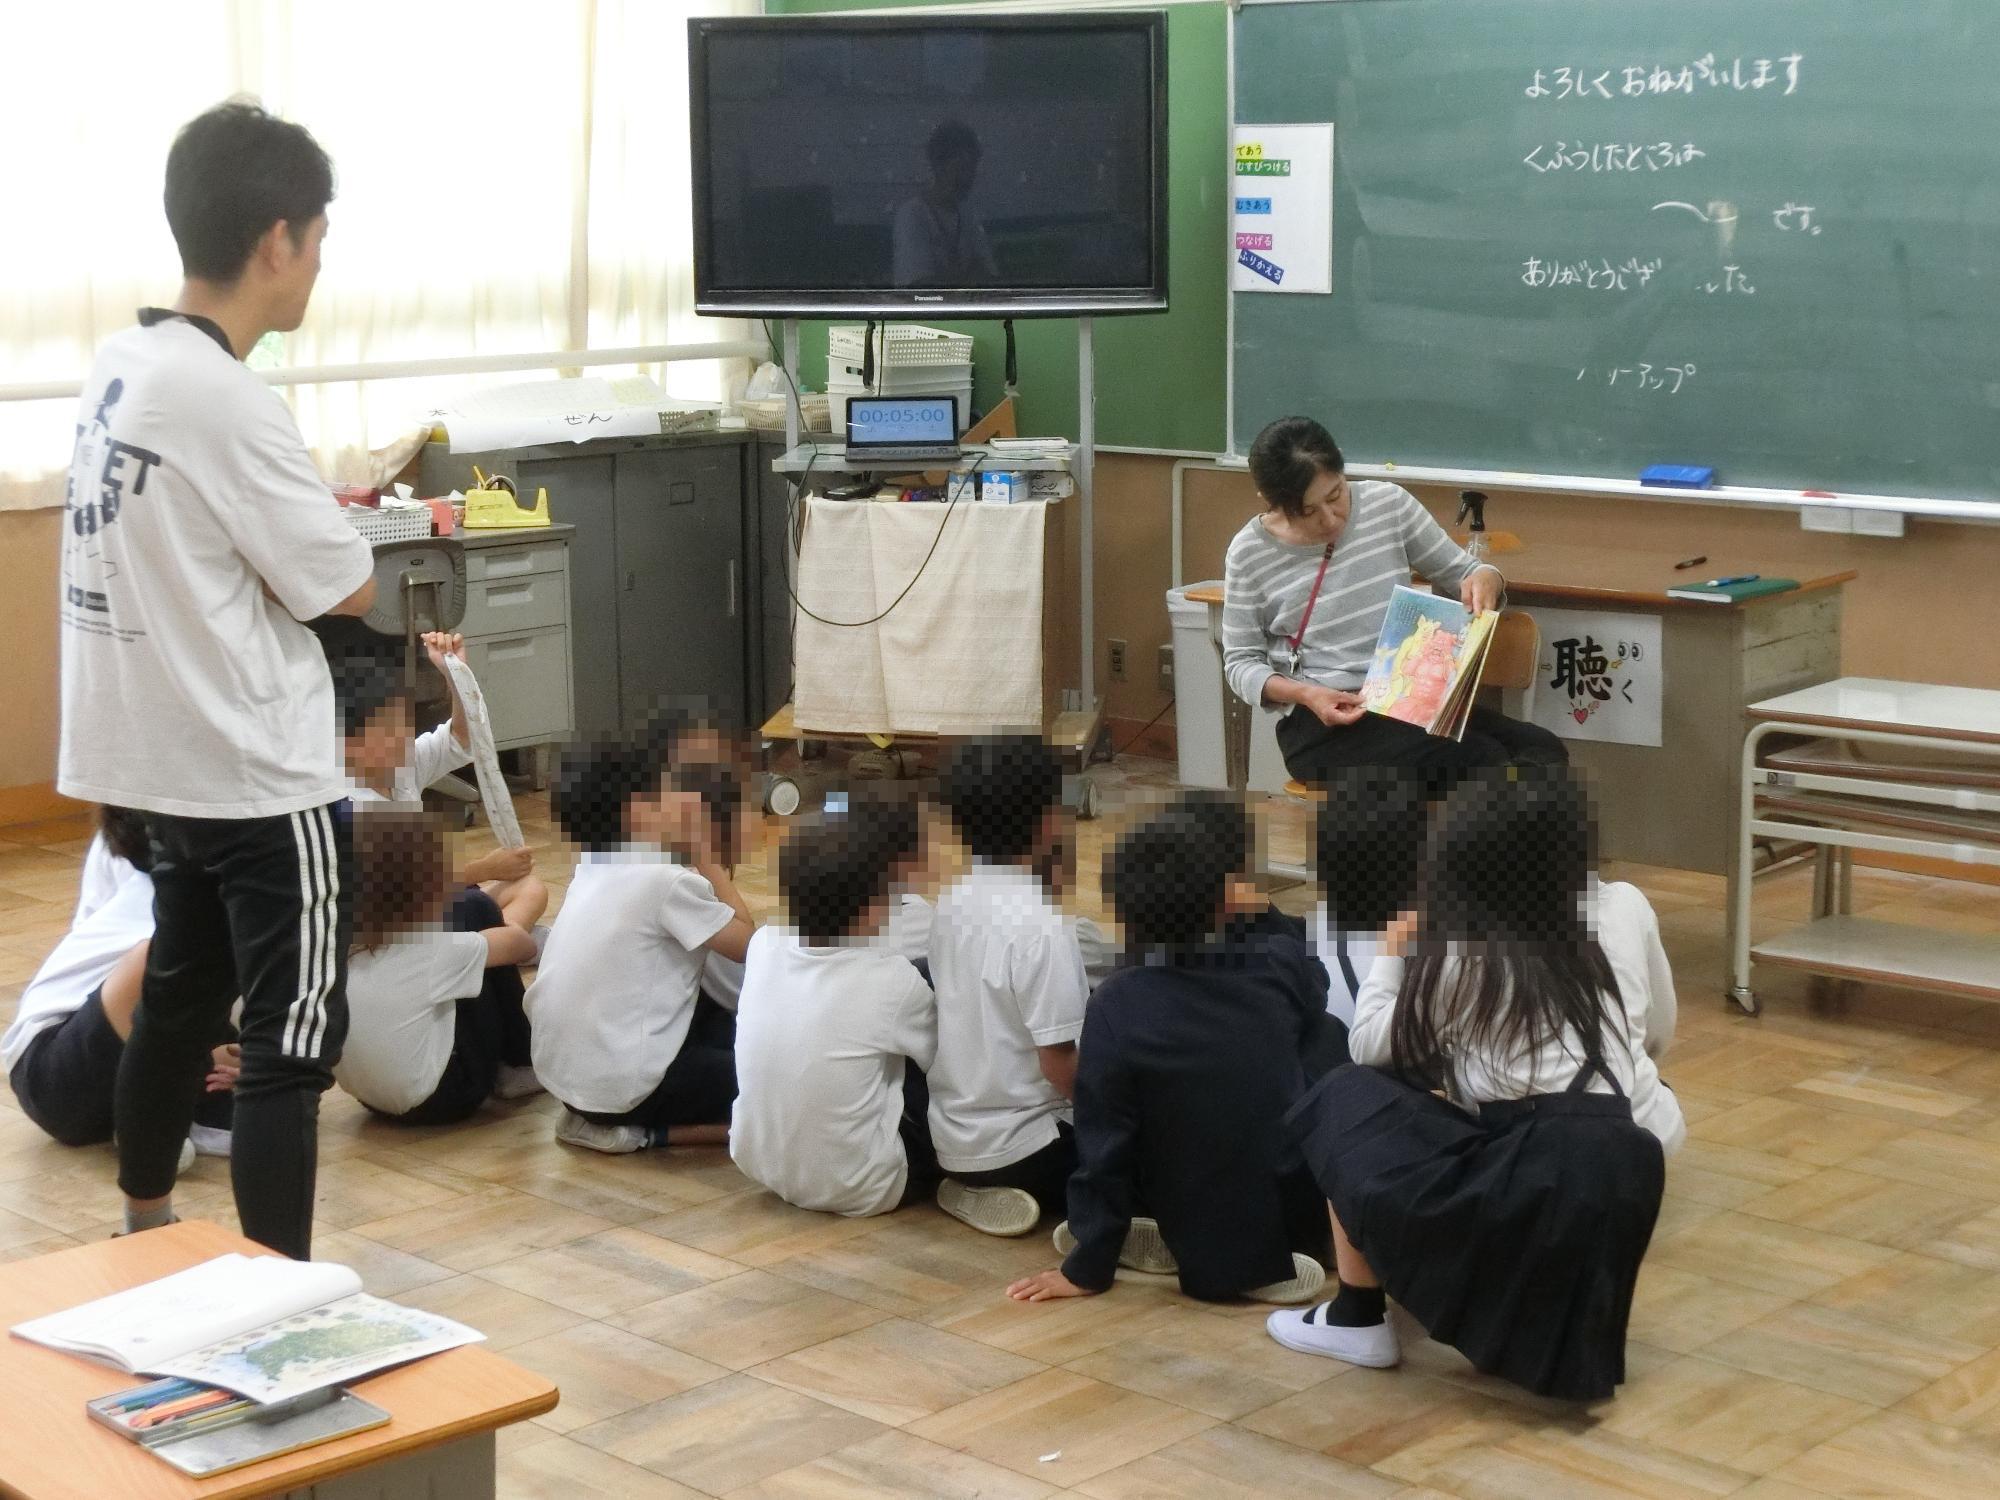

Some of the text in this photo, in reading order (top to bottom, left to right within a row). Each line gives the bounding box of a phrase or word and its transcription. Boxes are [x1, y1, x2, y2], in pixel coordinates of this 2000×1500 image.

[1236, 145, 1262, 156] であう
[1523, 140, 1706, 172] くふうしたところは
[1236, 161, 1290, 172] むすびつける
[1236, 236, 1272, 247] つなげる
[1239, 252, 1283, 281] ふりかえる
[563, 412, 613, 426] ぜん
[859, 409, 945, 423] 00:05:00
